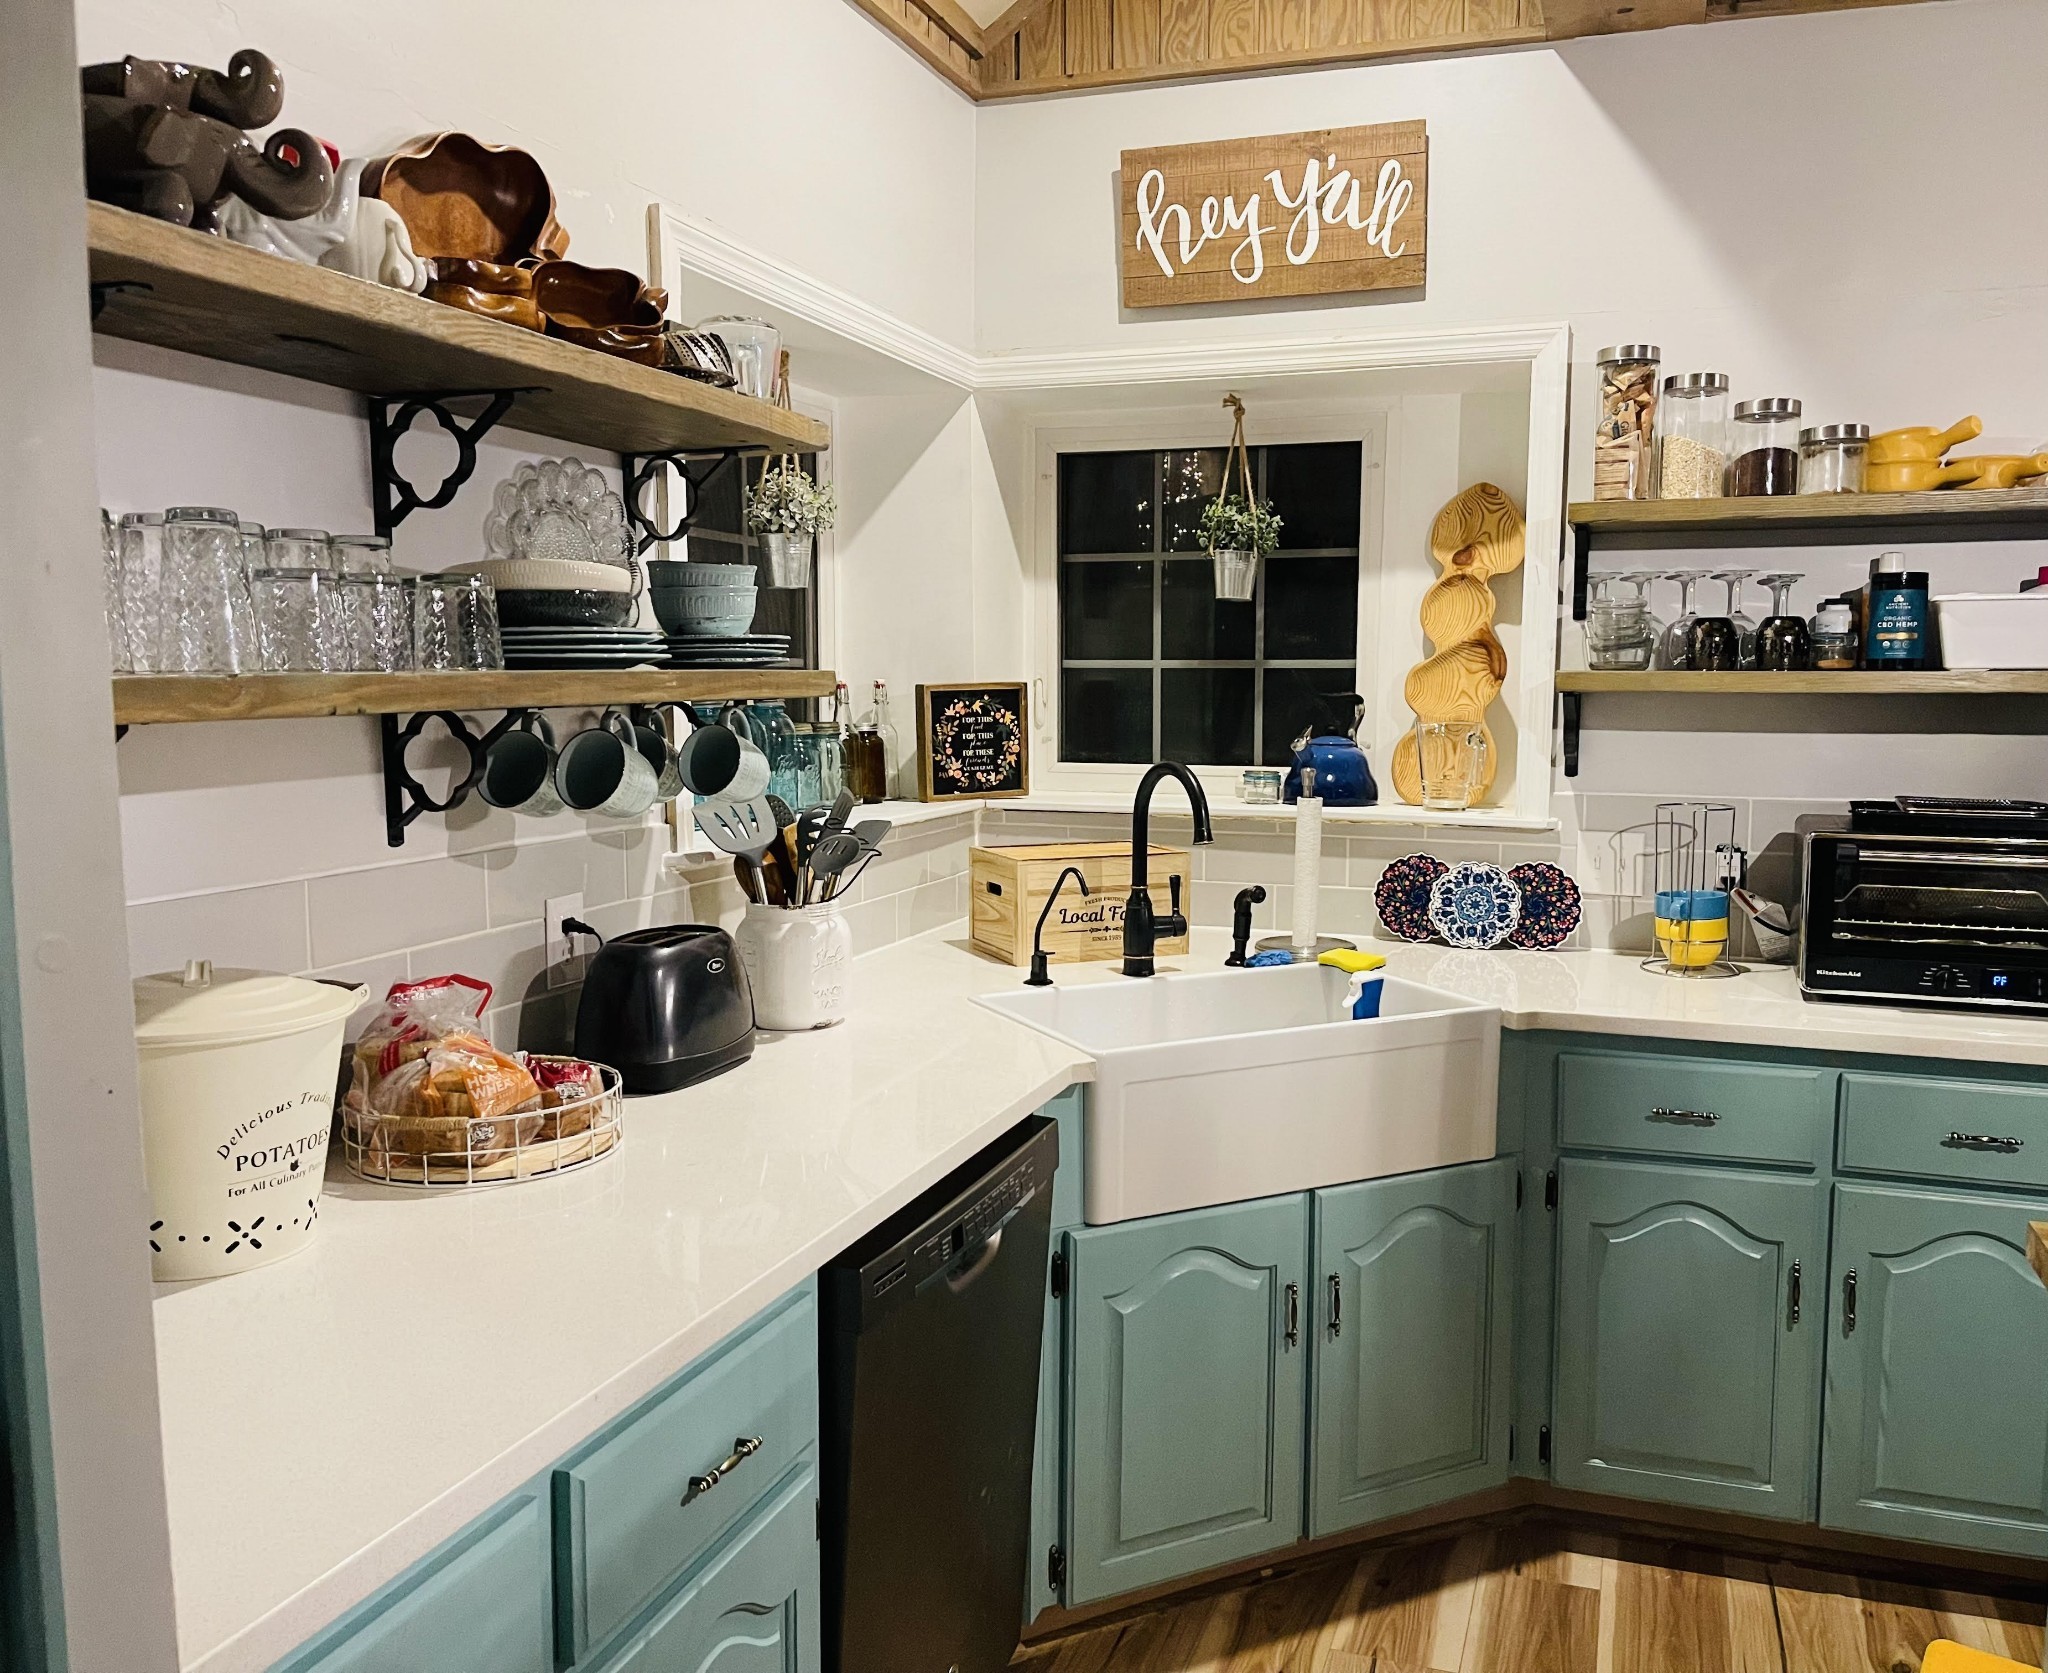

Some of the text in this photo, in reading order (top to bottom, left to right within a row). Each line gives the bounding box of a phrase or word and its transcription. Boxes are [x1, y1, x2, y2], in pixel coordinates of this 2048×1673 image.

[1136, 169, 1276, 284] hey
[975, 748, 994, 756] THESE
[1059, 904, 1126, 924] Local Fa
[1816, 969, 1862, 977] KitchenAid
[1993, 976, 2007, 986] PF
[216, 1100, 292, 1160] Delicious
[235, 1125, 330, 1172] POTATOES
[228, 1168, 306, 1198] For All Culinary
